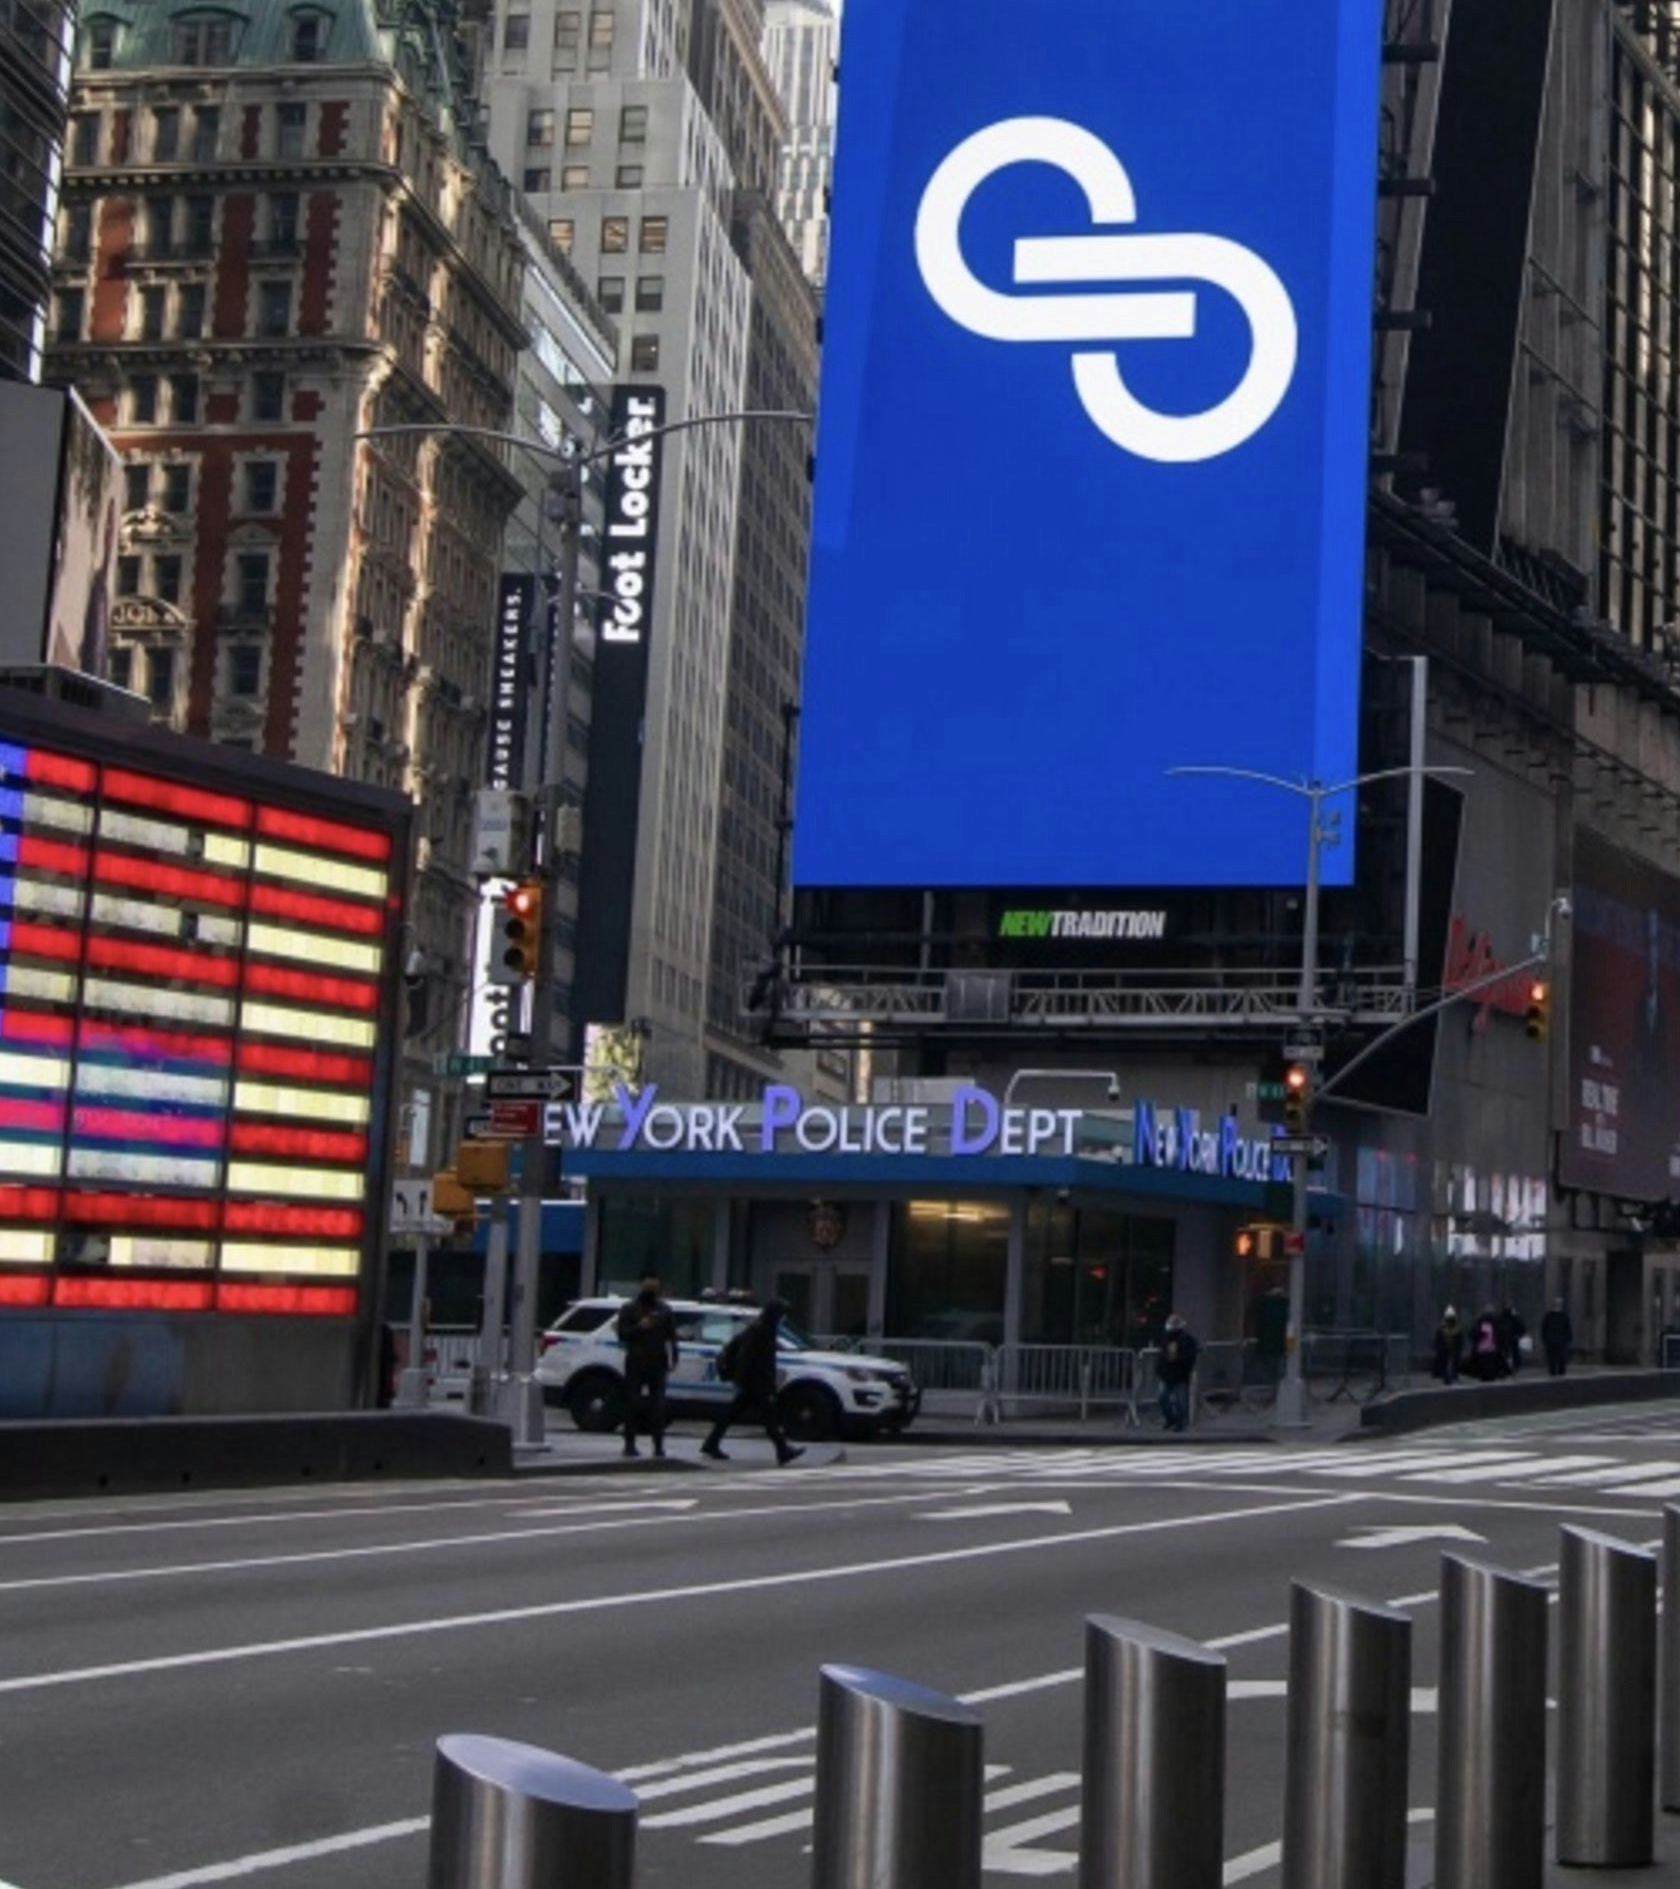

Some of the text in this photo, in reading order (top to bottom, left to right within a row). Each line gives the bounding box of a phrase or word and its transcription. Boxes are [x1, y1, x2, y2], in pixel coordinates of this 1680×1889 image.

[602, 396, 658, 645] Foot Locker
[612, 1082, 743, 1151] YORK
[761, 1083, 927, 1153] POLICE
[950, 1085, 1083, 1154] DEPT
